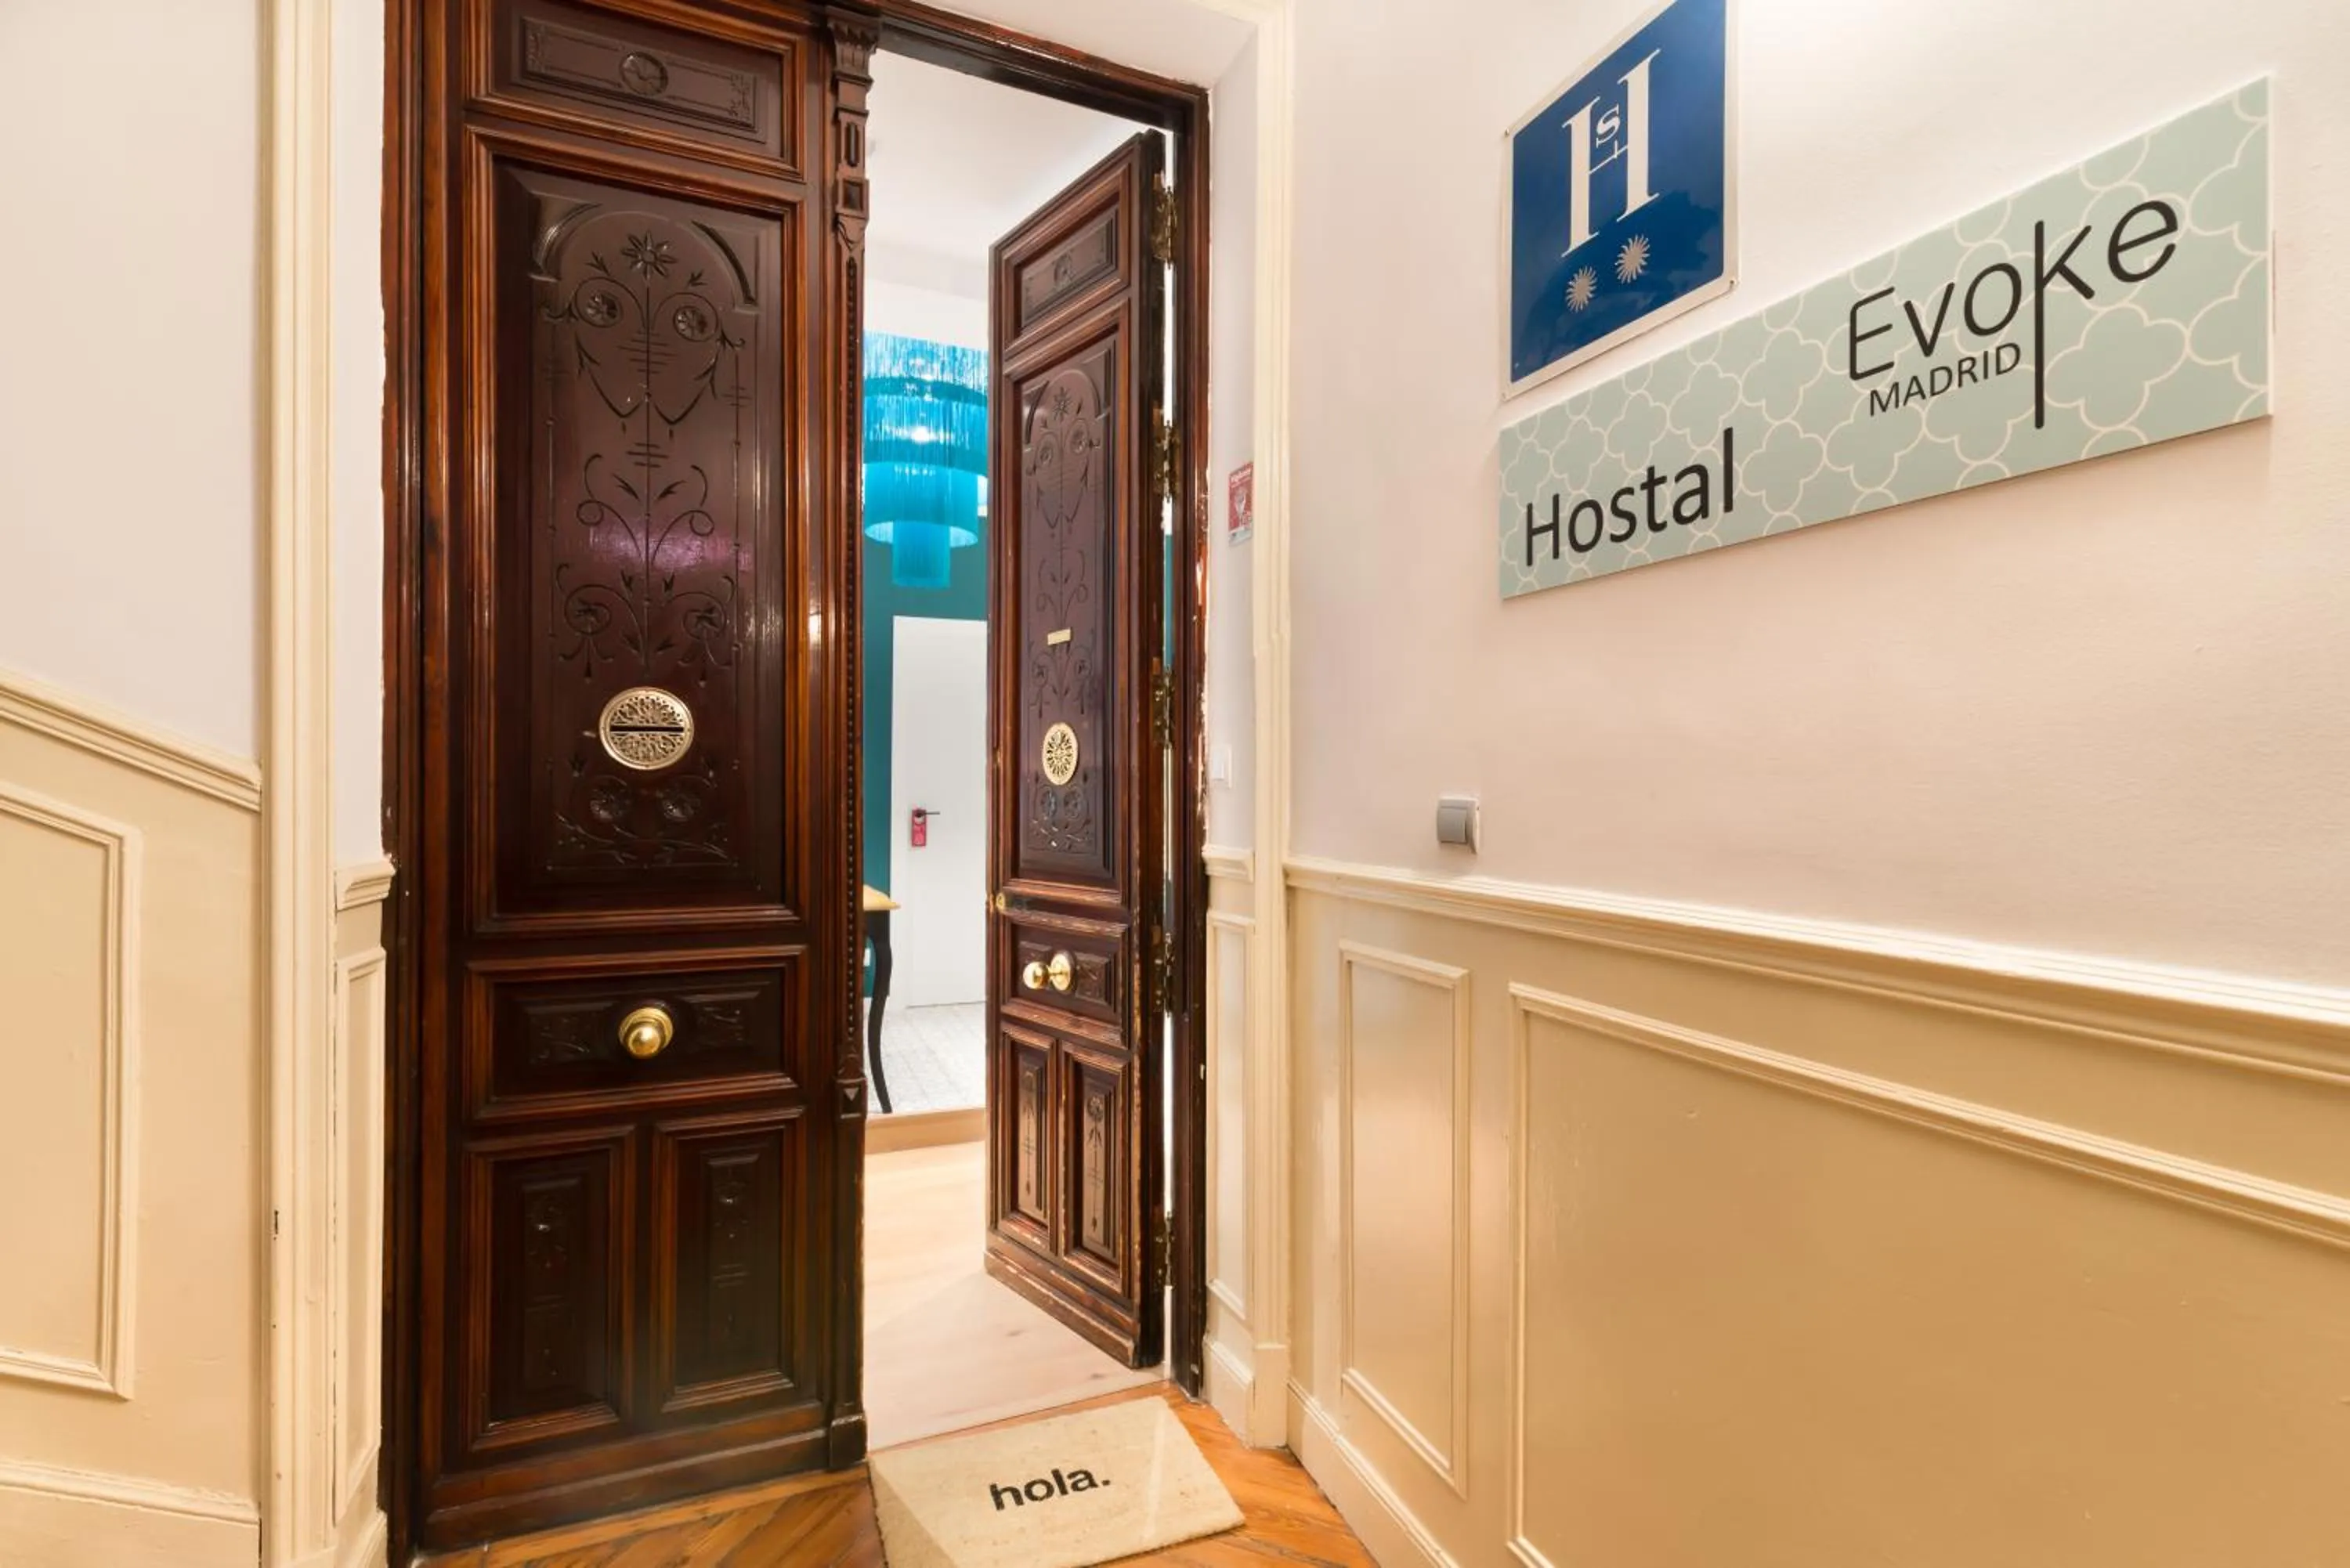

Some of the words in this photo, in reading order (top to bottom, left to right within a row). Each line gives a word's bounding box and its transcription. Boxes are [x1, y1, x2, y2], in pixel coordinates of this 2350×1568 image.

[1849, 200, 2178, 430] Evoke
[1870, 342, 2021, 417] MADRID
[1525, 426, 1734, 568] Hostal
[989, 1469, 1111, 1511] hola.
